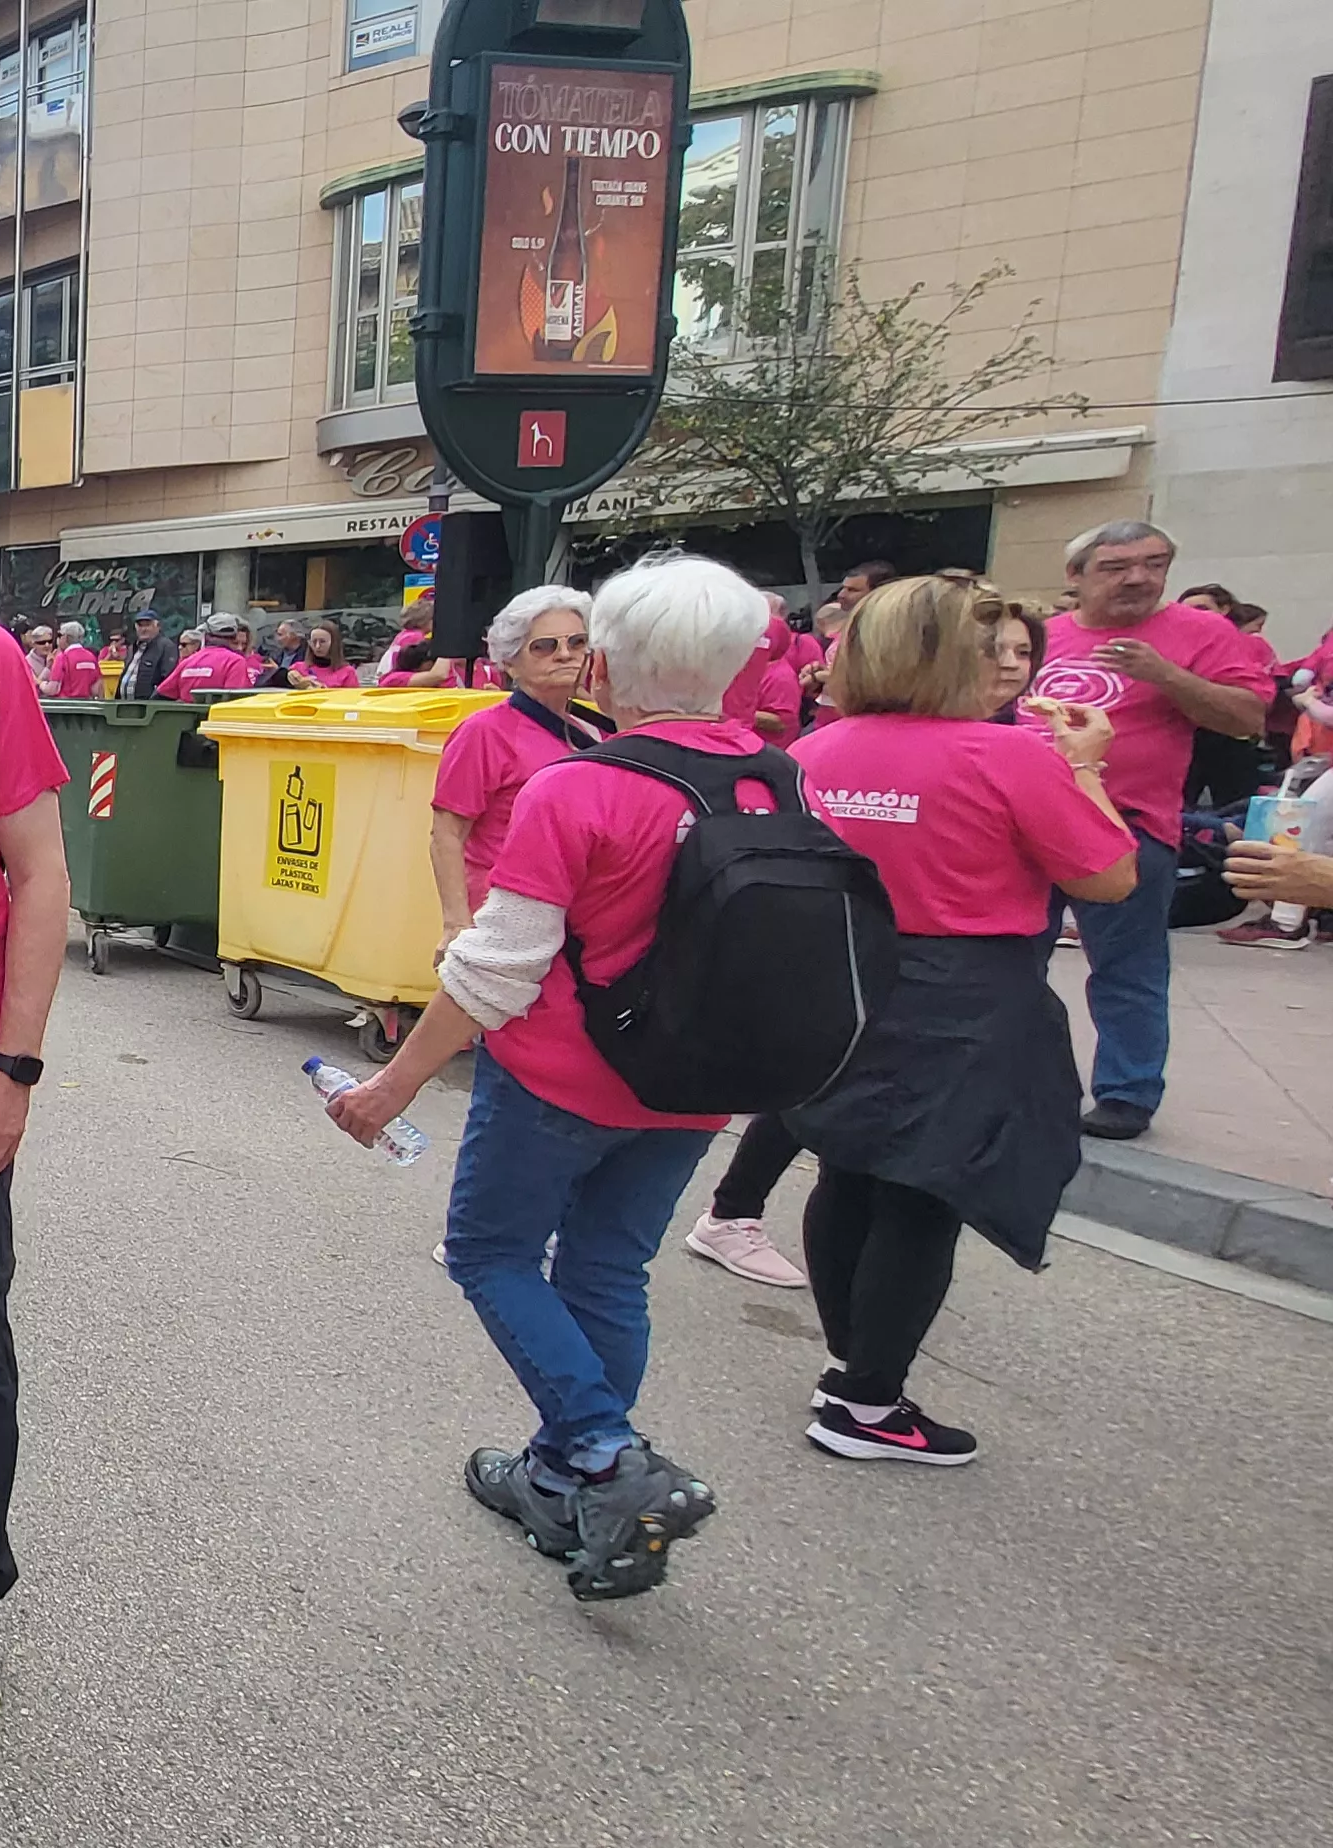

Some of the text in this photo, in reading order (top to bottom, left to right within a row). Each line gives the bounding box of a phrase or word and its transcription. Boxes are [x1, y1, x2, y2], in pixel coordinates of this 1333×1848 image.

[373, 20, 412, 37] REALE
[499, 75, 663, 127] TÓMATELA
[495, 123, 662, 159] CON TIEMPO
[573, 284, 584, 338] AMBAR
[347, 515, 423, 532] RESTAU
[42, 561, 129, 607] Granja
[815, 788, 920, 809] ARAGÓN
[277, 856, 319, 870] ENVASES DE
[271, 877, 319, 894] LATAS Y BRIKS
